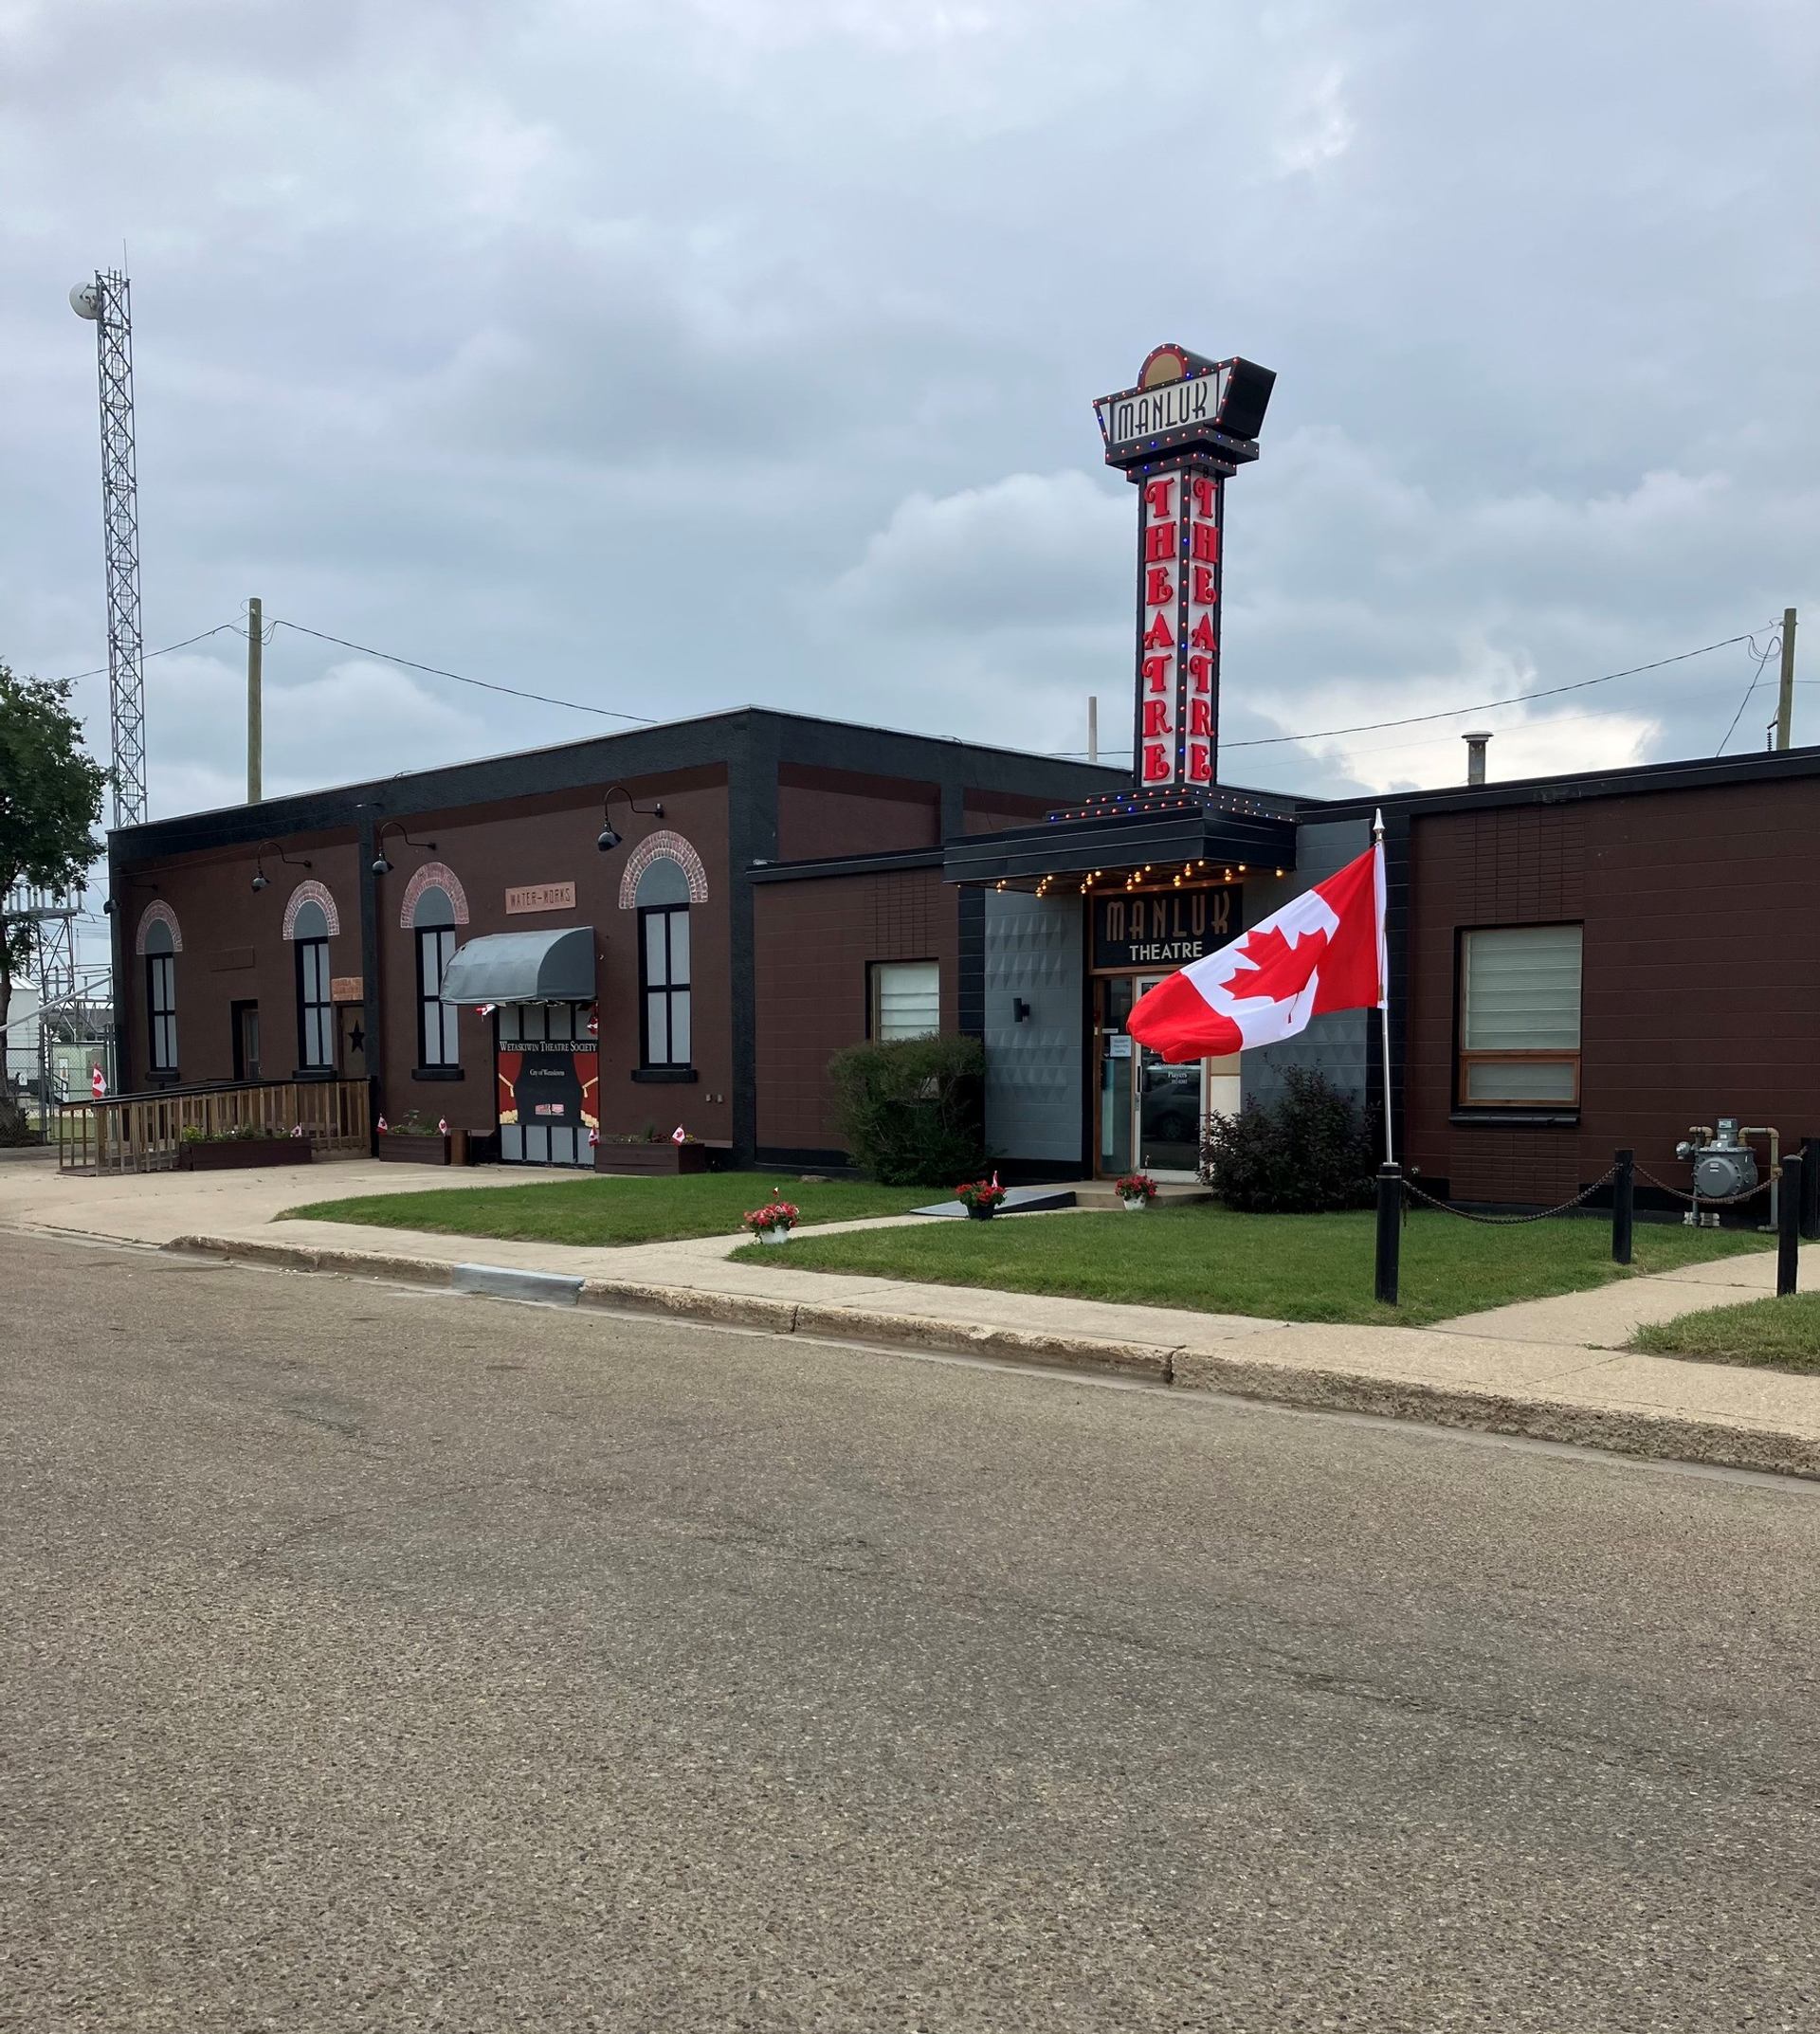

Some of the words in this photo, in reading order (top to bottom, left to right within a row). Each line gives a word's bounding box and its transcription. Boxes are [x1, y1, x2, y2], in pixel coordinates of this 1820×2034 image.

[1118, 381, 1208, 440] MANLUK
[1141, 477, 1176, 782] THEATRE
[1189, 477, 1219, 782] THEATRE
[510, 887, 571, 907] WATER-WORKS
[1105, 891, 1229, 941] MANLUK
[1129, 941, 1203, 961] THEATRE
[539, 1042, 569, 1051] THEATRE
[570, 1041, 597, 1051] SOCIETY
